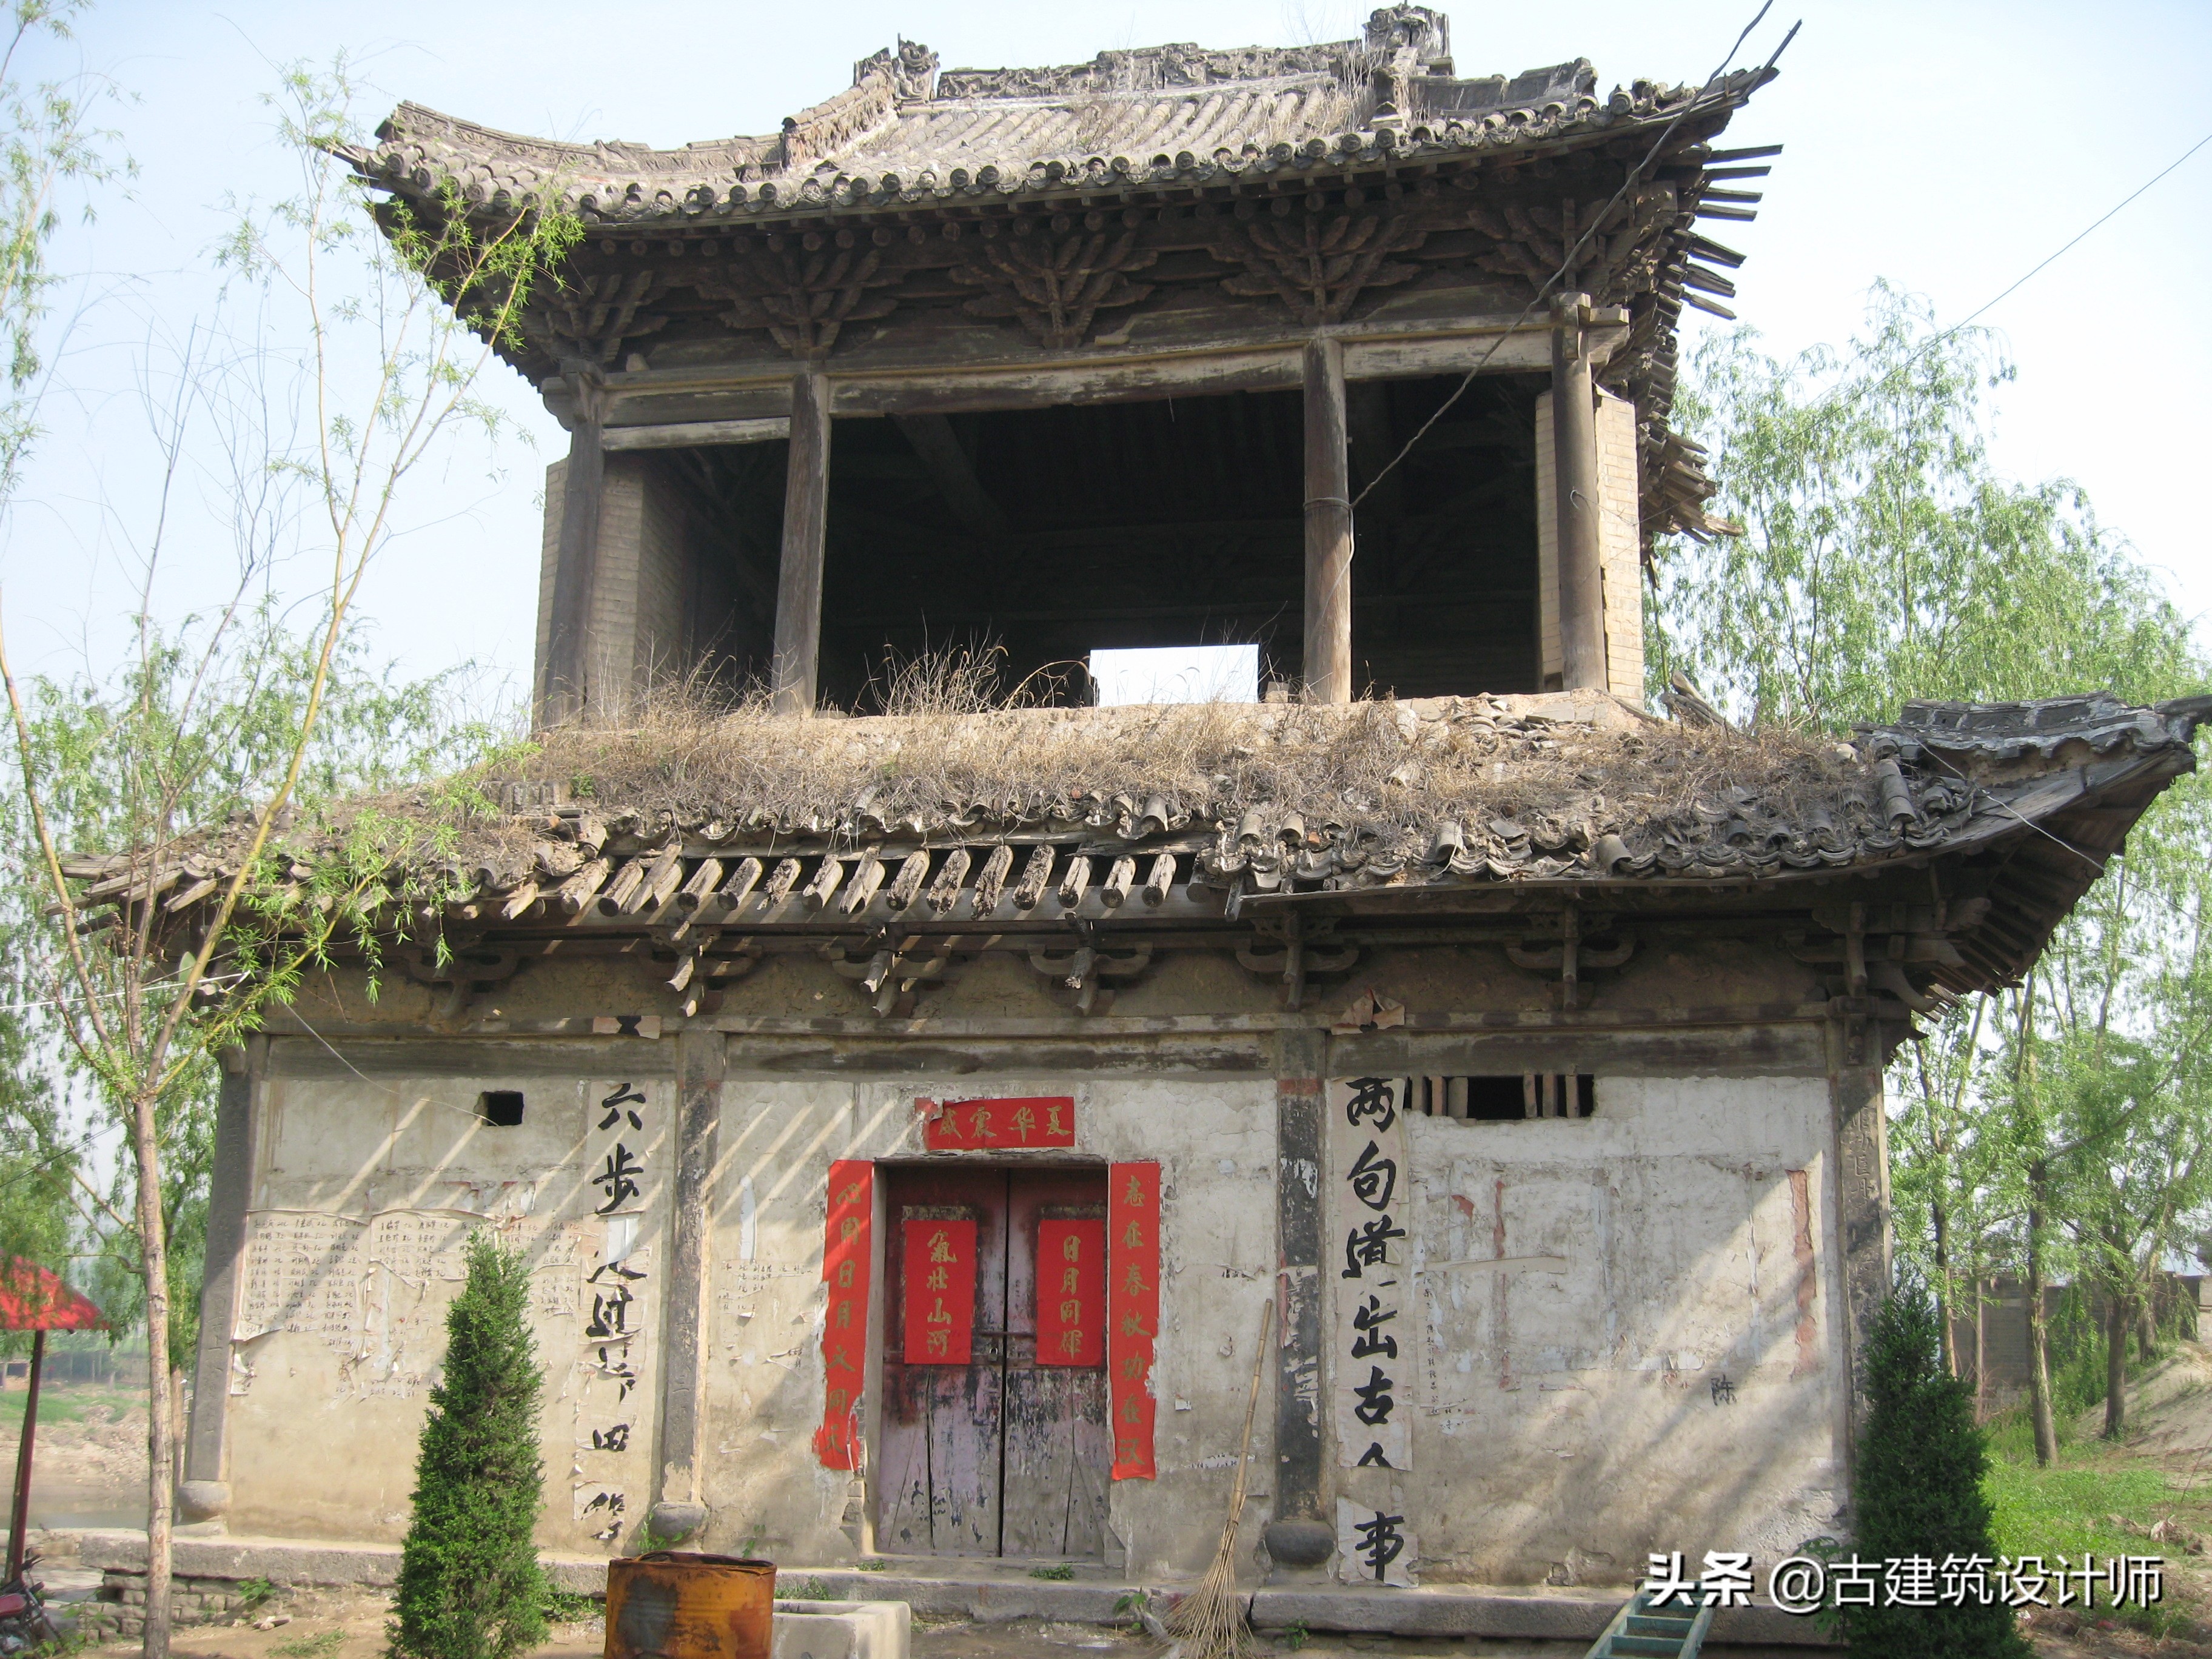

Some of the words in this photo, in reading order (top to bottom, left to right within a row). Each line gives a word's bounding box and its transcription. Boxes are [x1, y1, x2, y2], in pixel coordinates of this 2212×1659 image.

[939, 1106, 1071, 1143] 威震华夏
[1119, 1176, 1151, 1466] 志在春秋功在汉
